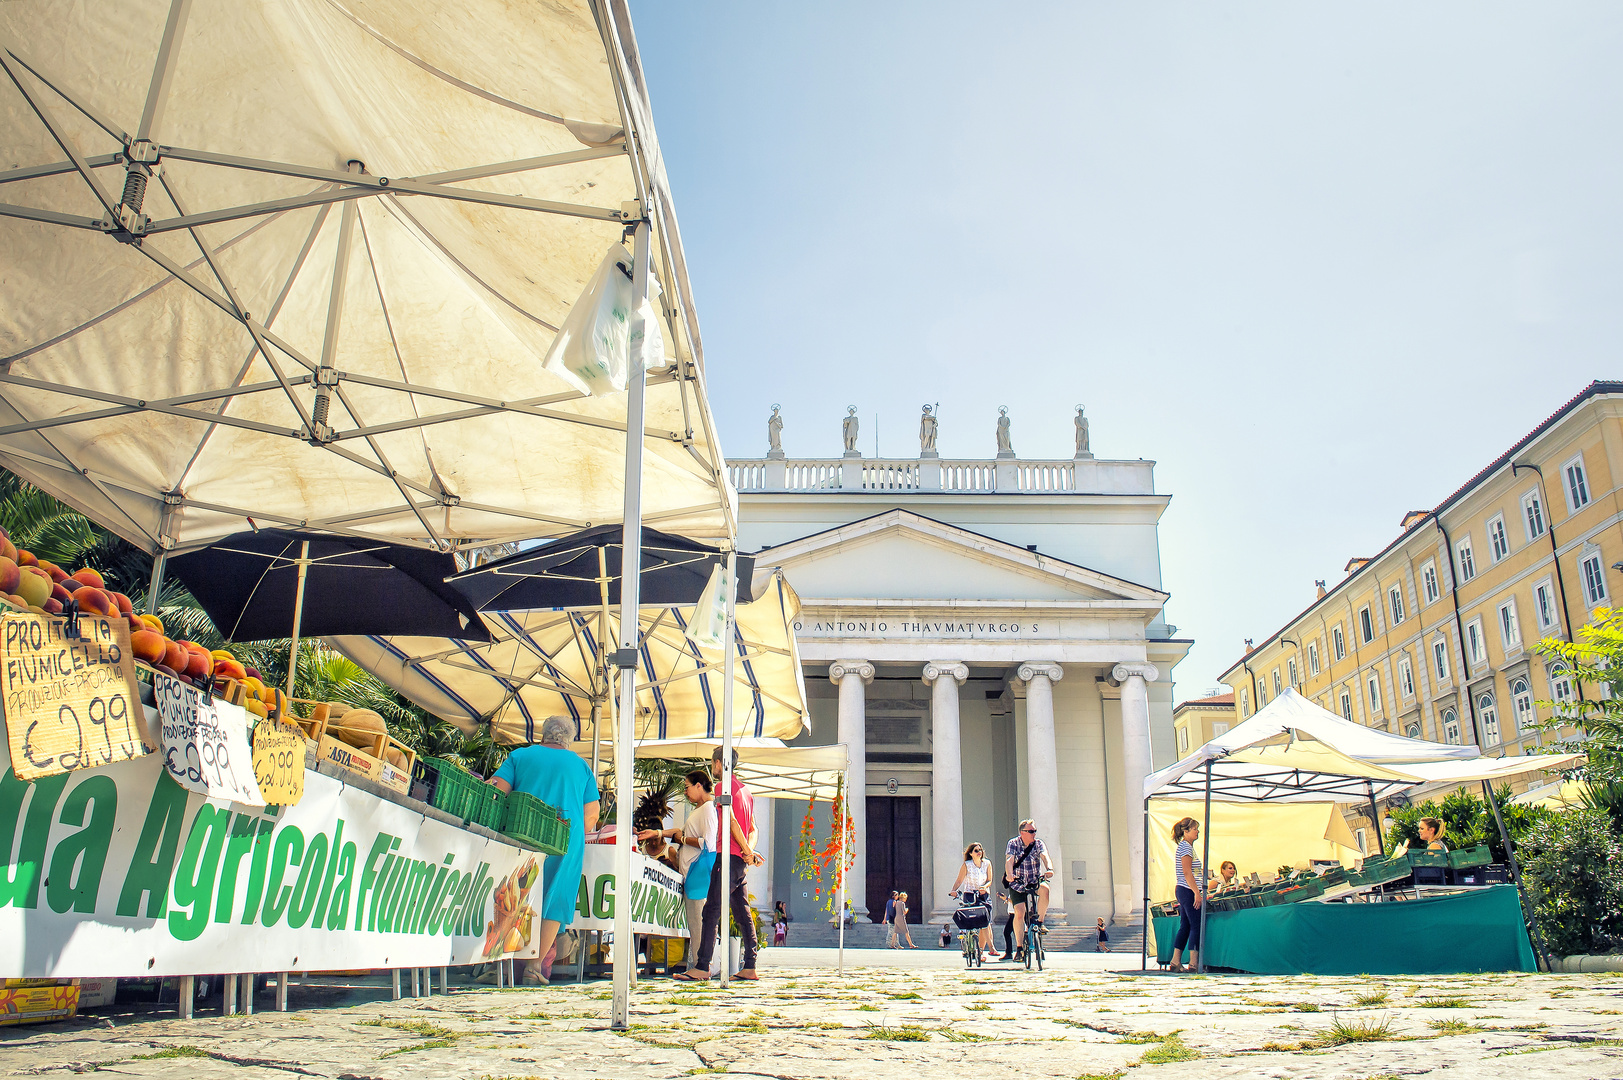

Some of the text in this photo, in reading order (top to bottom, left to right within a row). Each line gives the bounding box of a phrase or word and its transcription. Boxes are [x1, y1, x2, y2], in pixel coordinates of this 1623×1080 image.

[814, 621, 888, 633] ANTONIO
[901, 622, 1020, 633] THAVMATVRGO
[1032, 623, 1040, 633] S
[7, 643, 122, 690] FIUMICELLO
[116, 765, 357, 942] Agricola
[353, 831, 494, 938] Fiumicello
